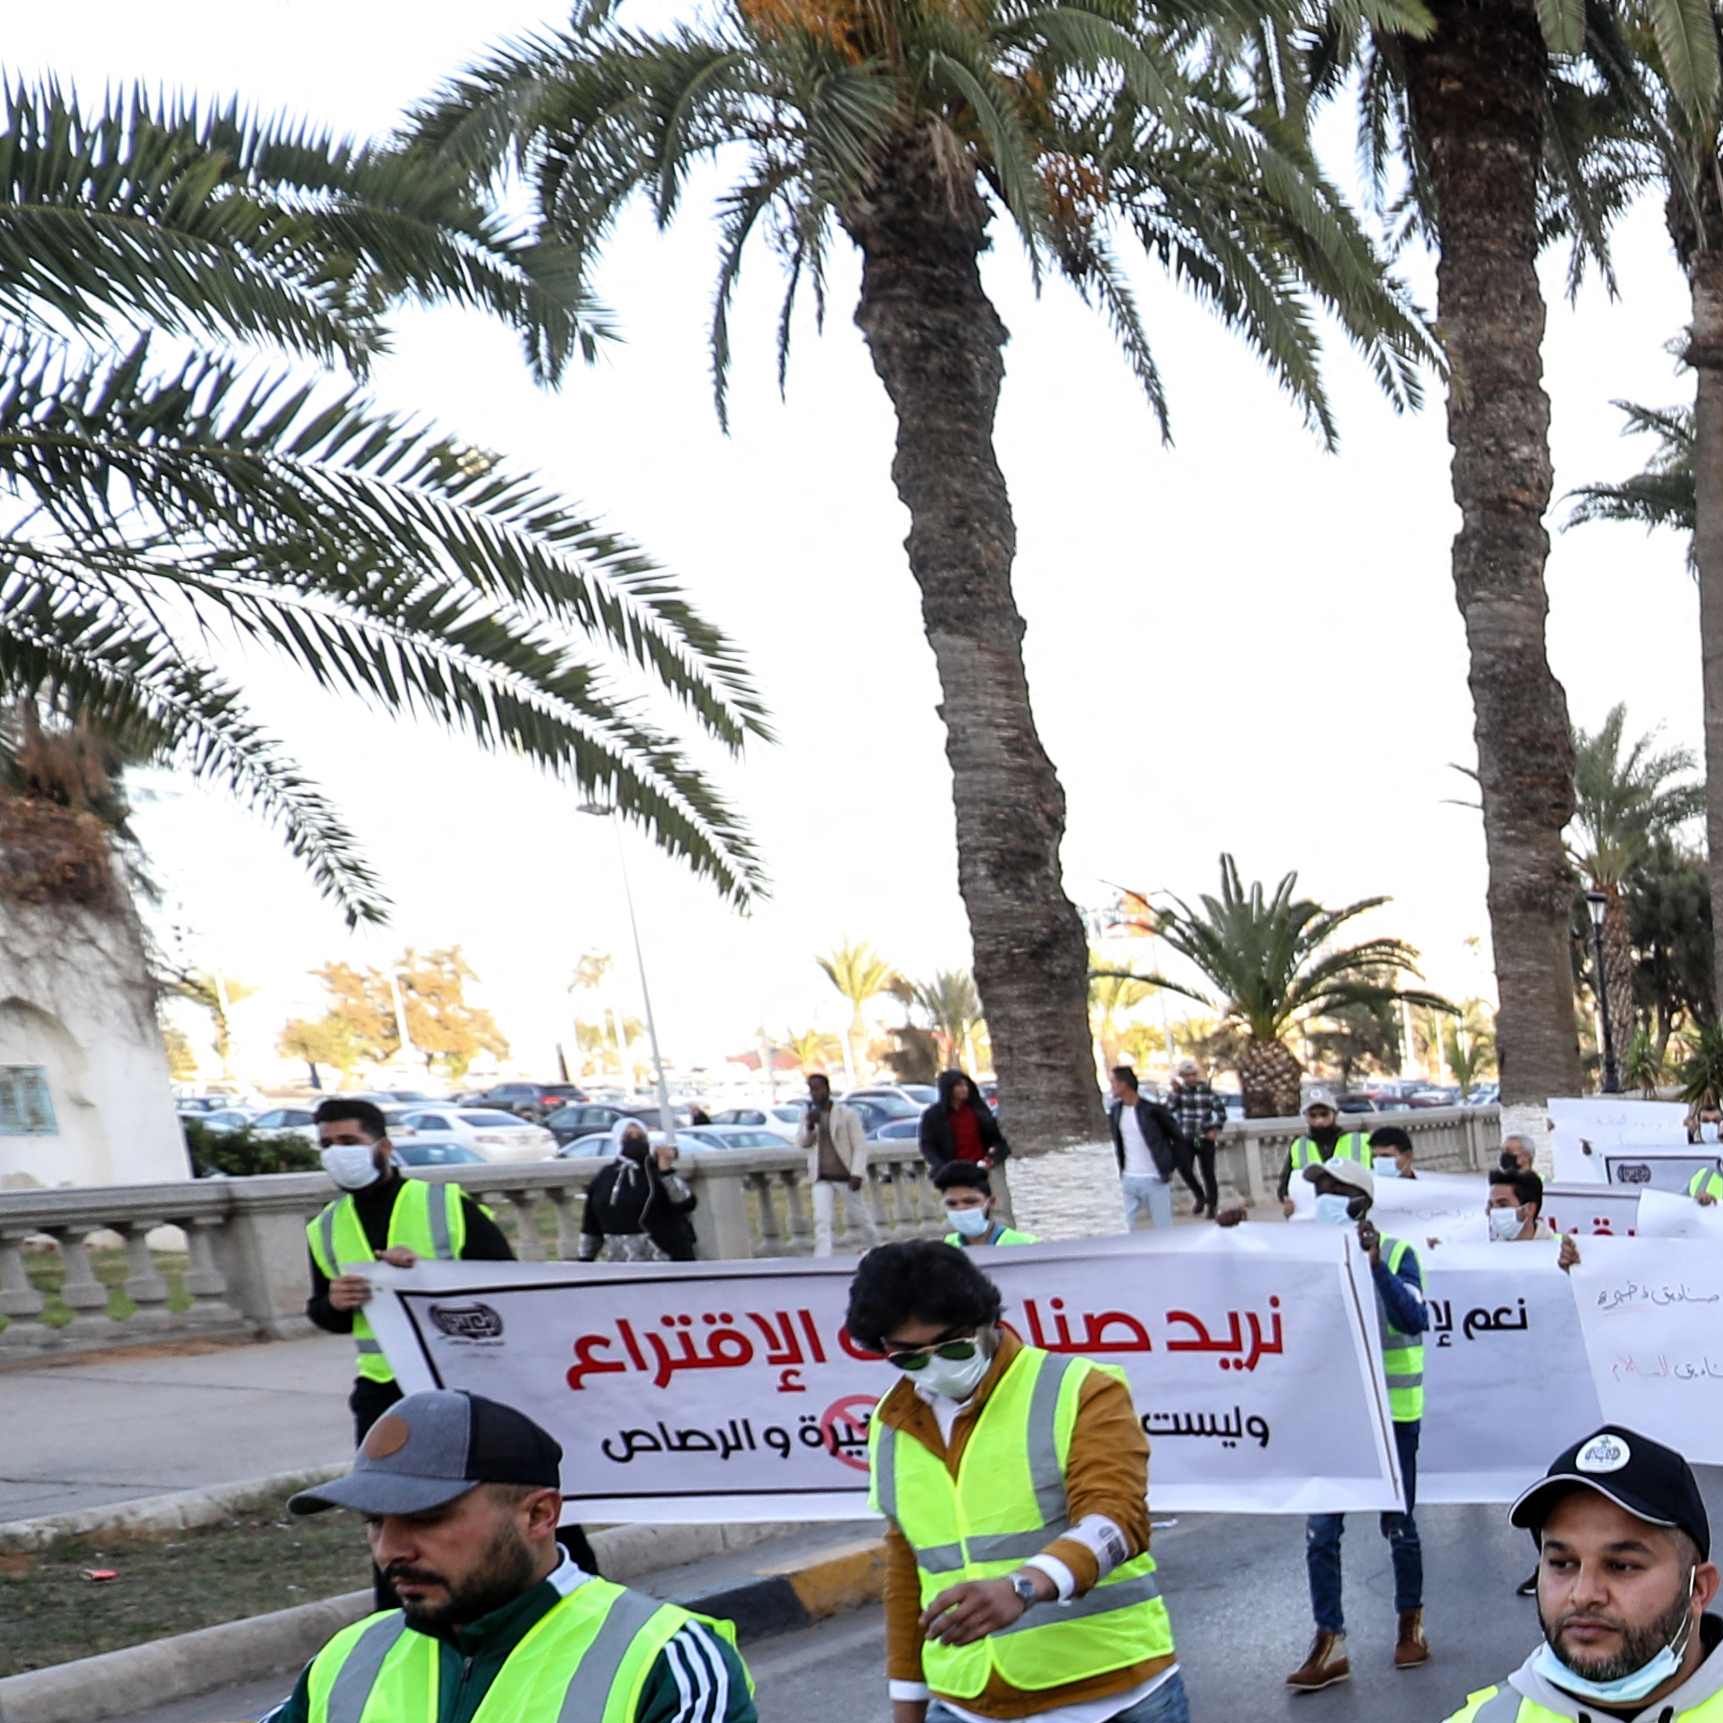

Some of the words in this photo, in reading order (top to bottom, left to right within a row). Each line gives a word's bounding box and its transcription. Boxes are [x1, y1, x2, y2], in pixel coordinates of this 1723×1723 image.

[1166, 1295, 1284, 1372] نريد
[1462, 1296, 1529, 1342] نعم
[565, 1308, 827, 1394] الإقتراع
[600, 1416, 758, 1464] الرصاص
[763, 1426, 792, 1460] و
[1140, 1405, 1271, 1449] وليست
